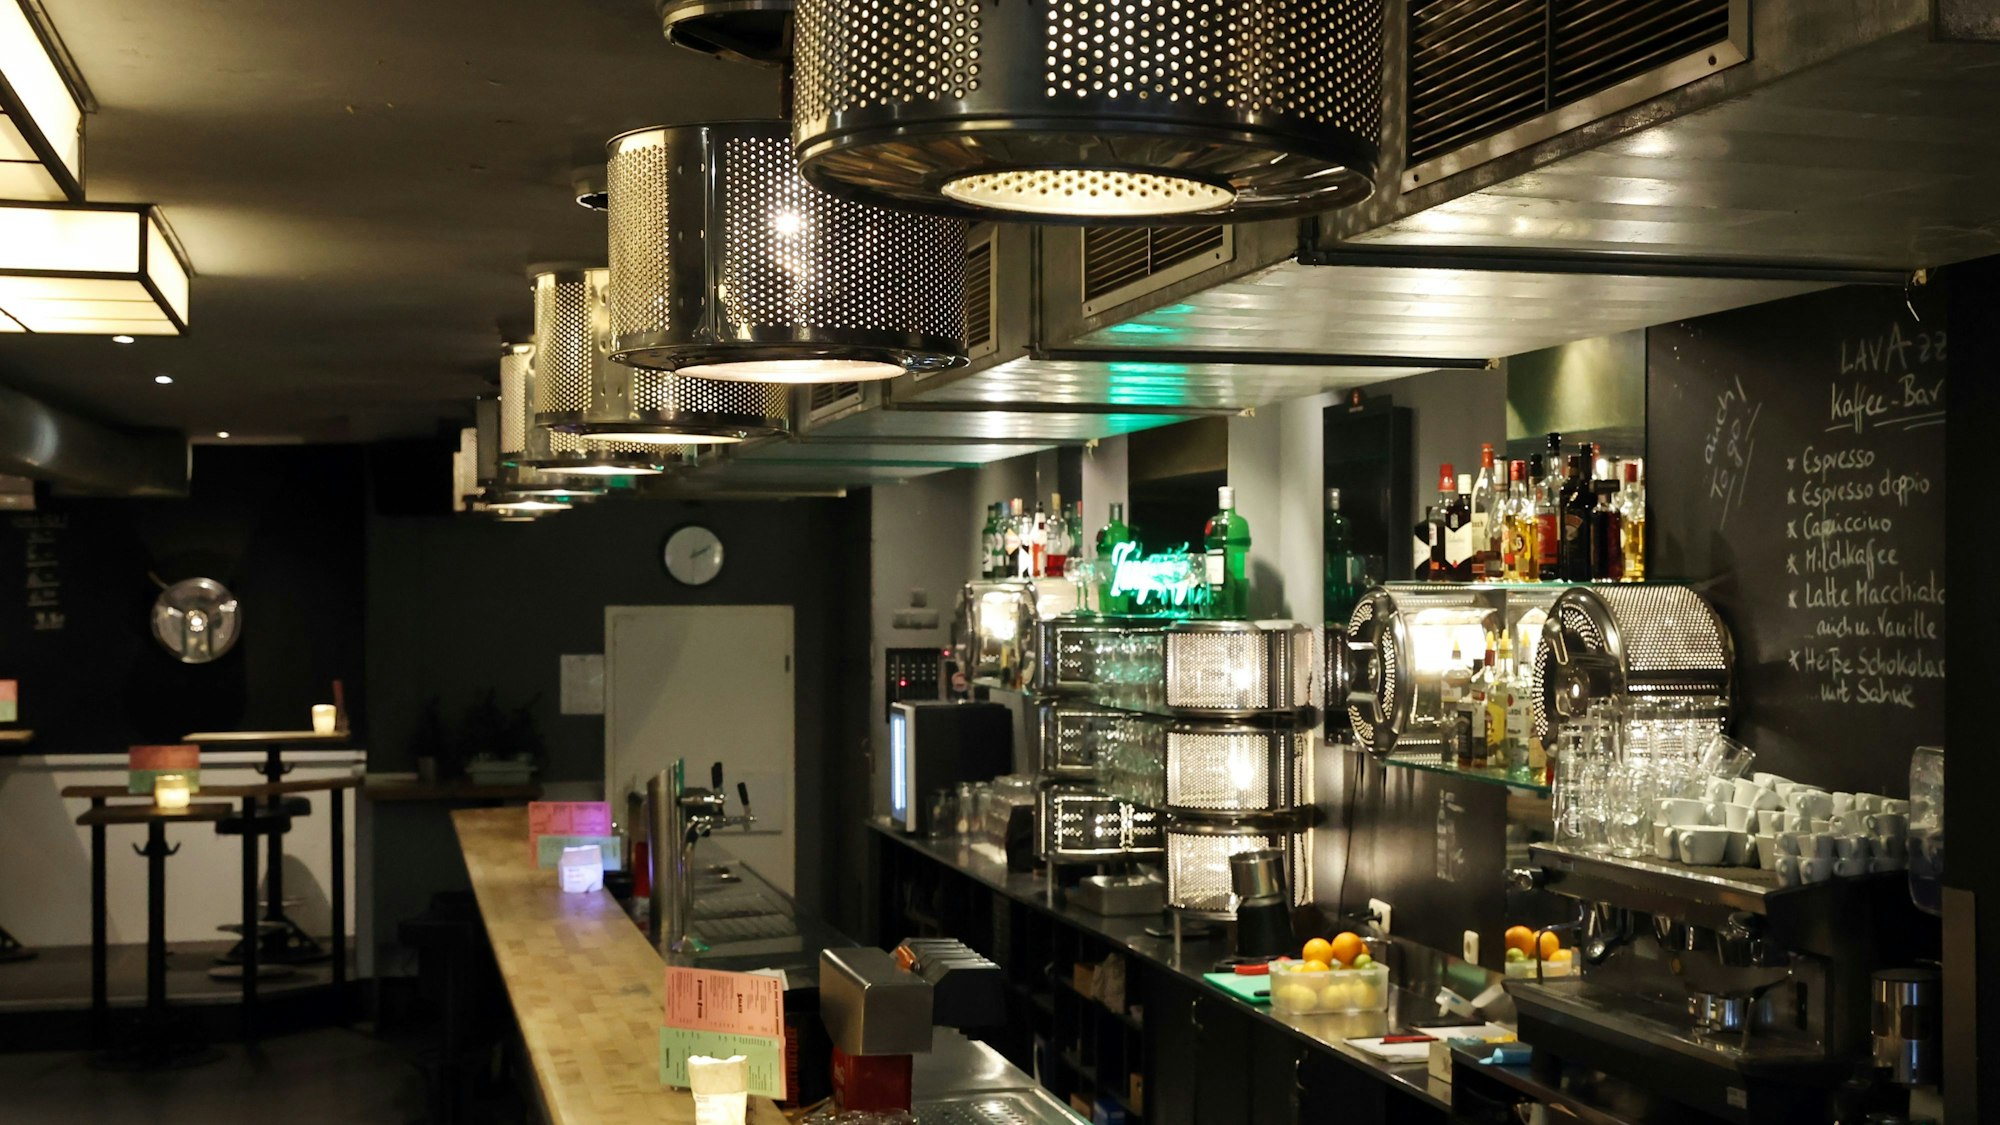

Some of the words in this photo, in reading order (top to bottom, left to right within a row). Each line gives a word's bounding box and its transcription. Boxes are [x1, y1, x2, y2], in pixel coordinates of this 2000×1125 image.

[1803, 446, 1875, 483] Espresso
[1802, 480, 1873, 518] Espresso
[1879, 468, 1930, 506] doppio
[1806, 576, 1850, 608] Latte
[1878, 608, 1937, 639] Vanille
[1805, 647, 1853, 681] Heiße
[1856, 678, 1916, 709] Sahne
